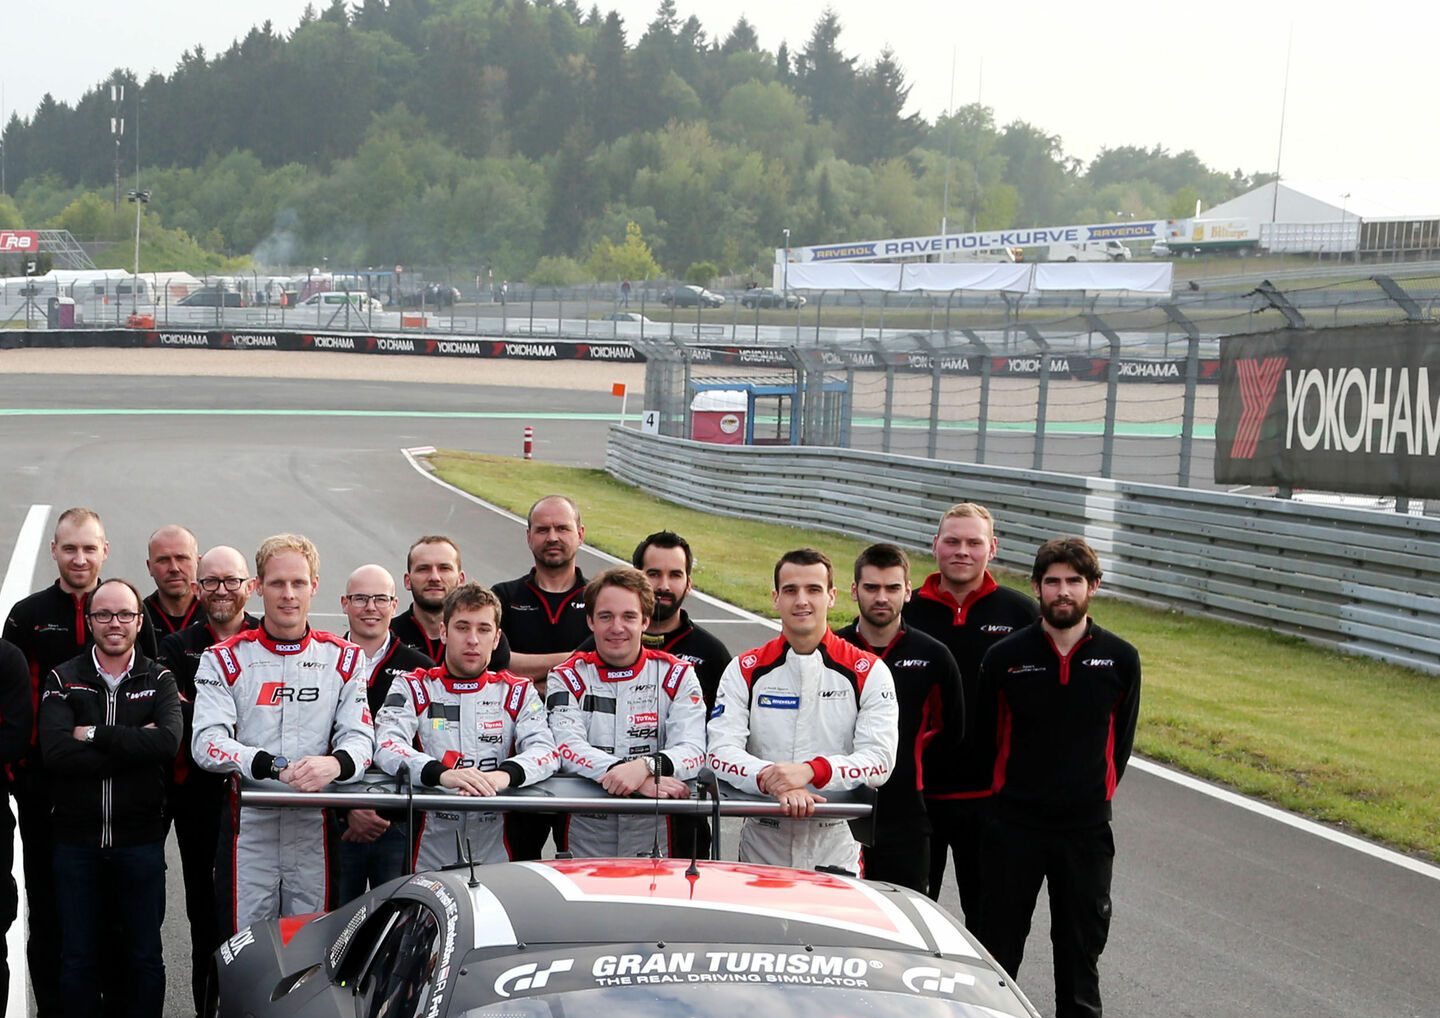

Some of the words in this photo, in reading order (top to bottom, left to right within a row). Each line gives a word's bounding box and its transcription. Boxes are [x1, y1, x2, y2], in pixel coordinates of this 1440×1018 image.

[885, 229, 1078, 254] RAVENOL-KURVE
[160, 333, 208, 346] YOKOHAMA
[232, 335, 277, 347] YOKOHAMA
[314, 336, 355, 349] YOKOHAMA
[437, 342, 480, 354] YOKOHAMA
[506, 343, 557, 357] YOKOHAMA
[589, 346, 635, 359] YOKOHAMA
[646, 413, 655, 427] 4
[838, 764, 888, 779] TOTAL
[592, 953, 694, 978] GRAN
[595, 977, 632, 987] THE
[636, 974, 684, 985] REAL
[688, 972, 761, 982] DRIVING
[766, 974, 869, 988] SIMULATOR
